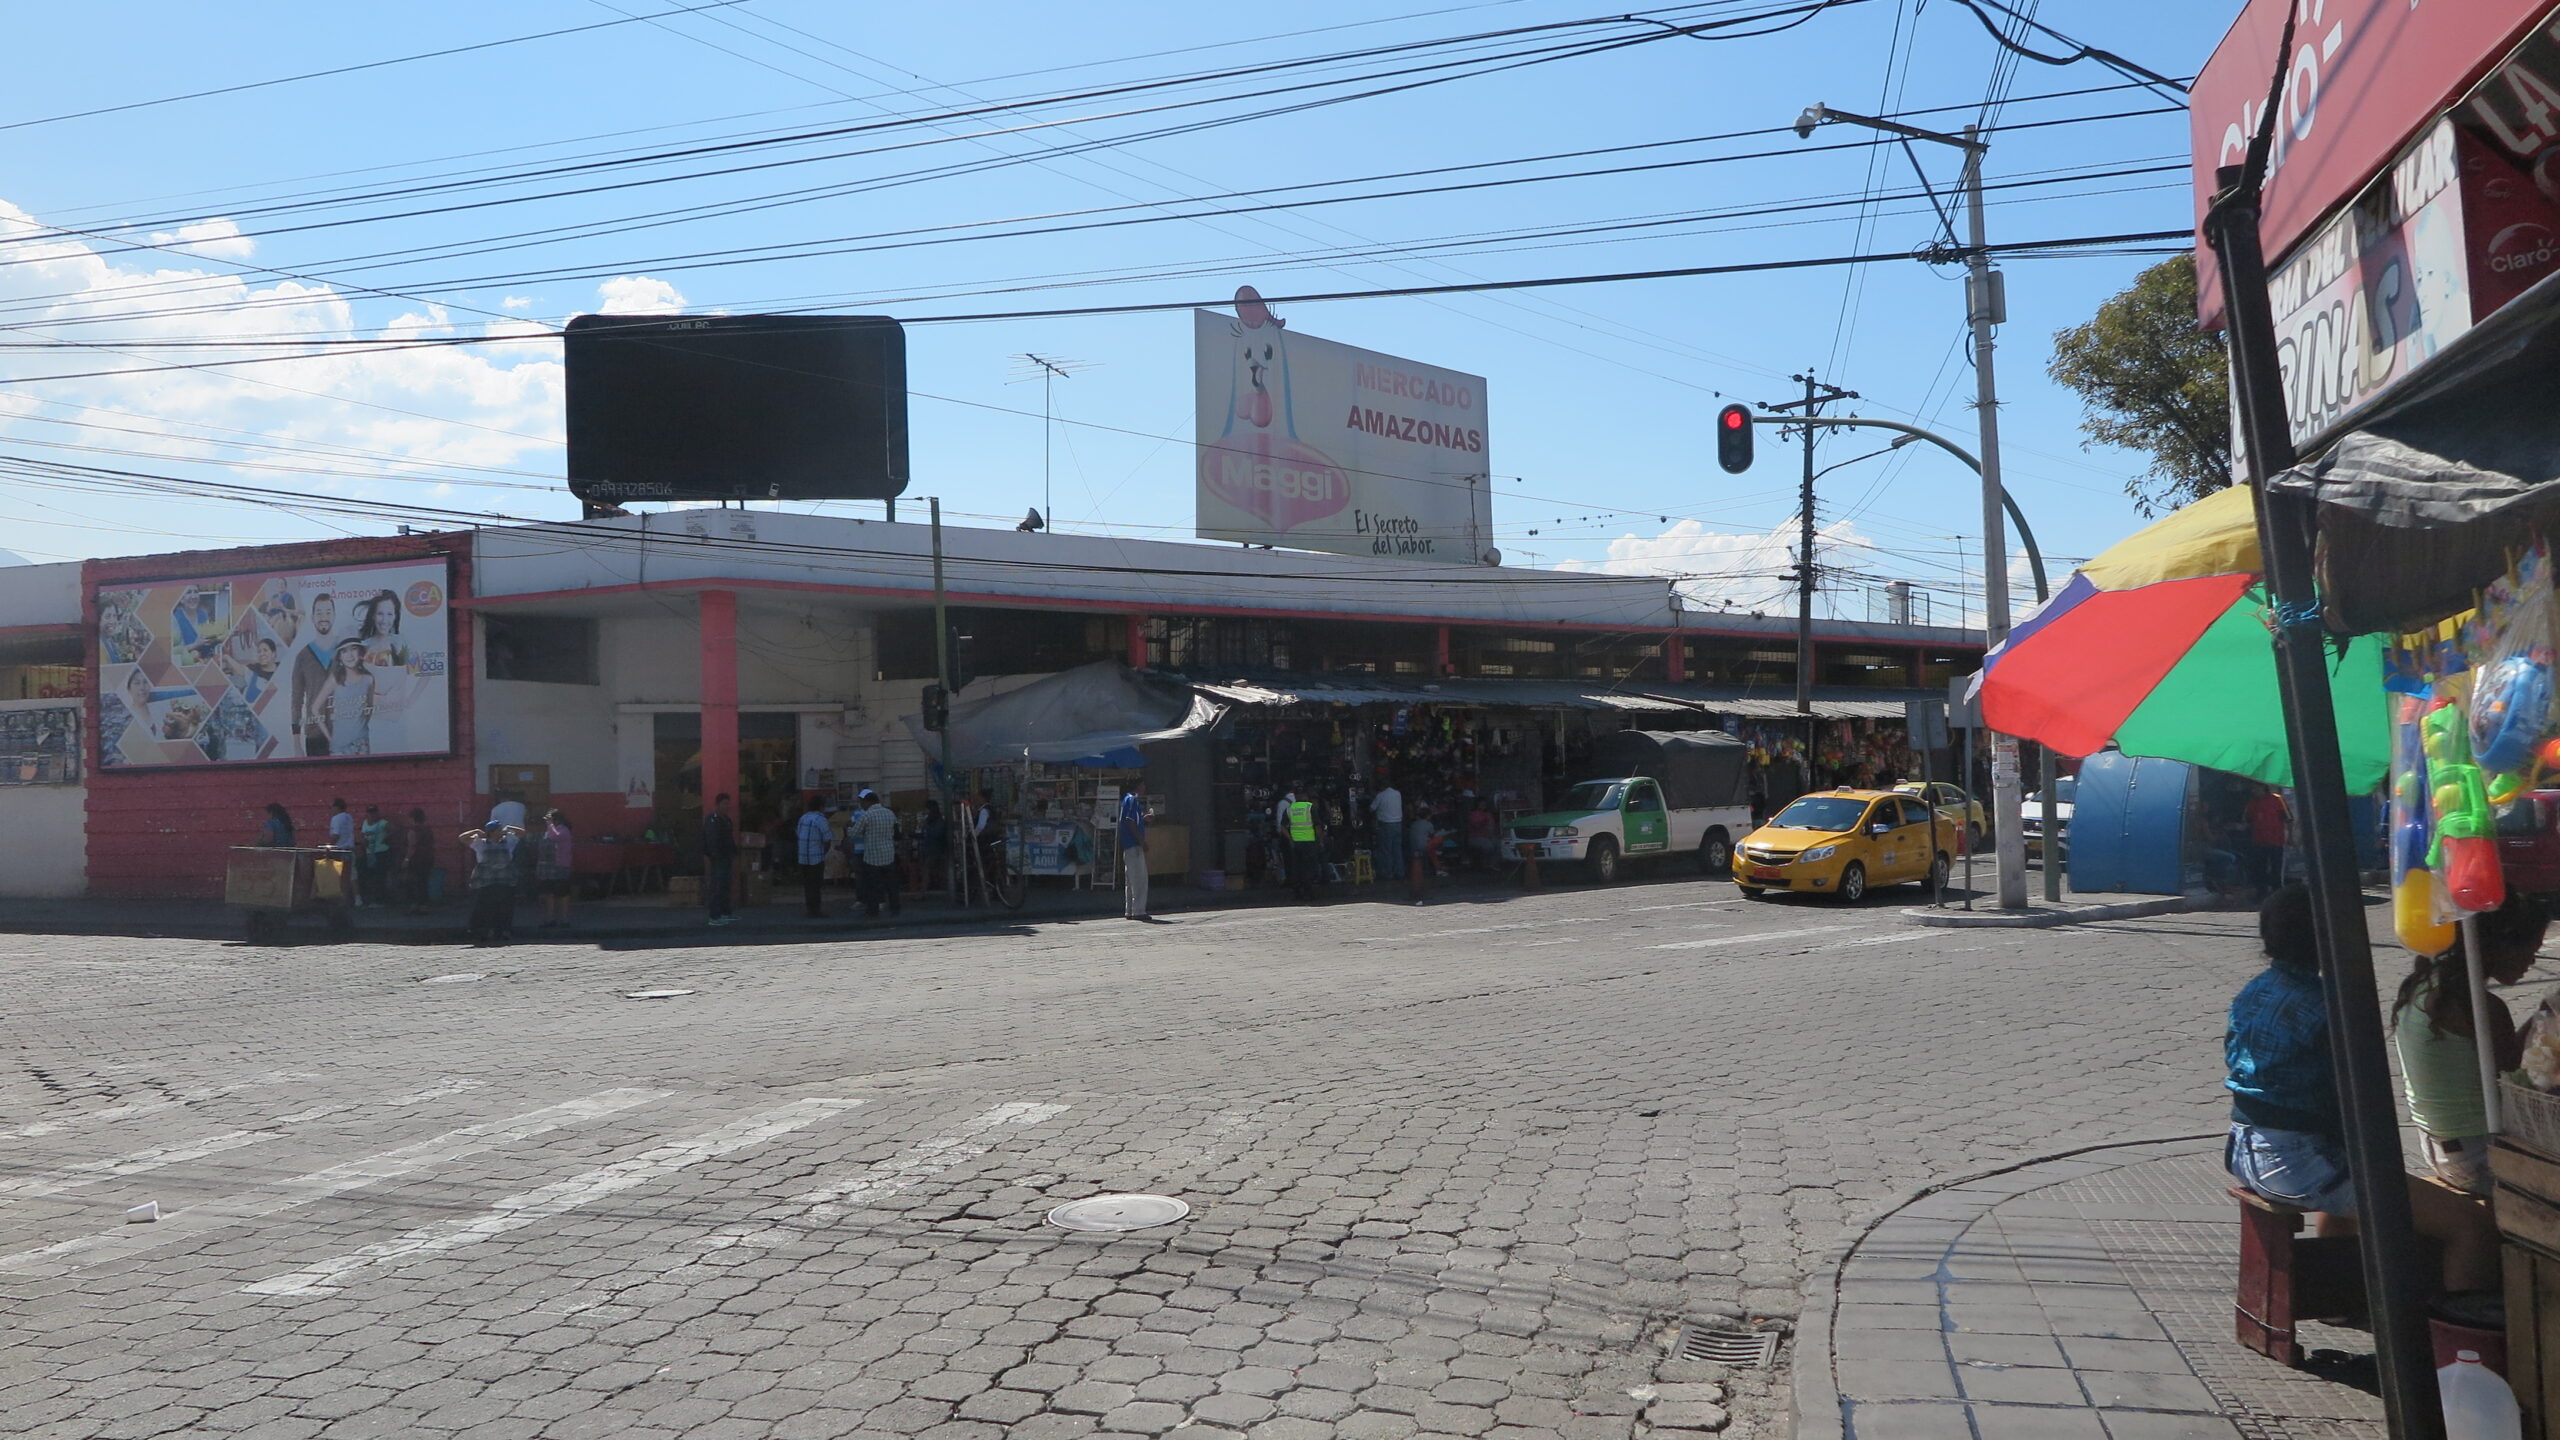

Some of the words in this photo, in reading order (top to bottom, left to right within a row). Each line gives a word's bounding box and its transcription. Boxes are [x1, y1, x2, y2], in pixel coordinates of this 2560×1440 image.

[2306, 223, 2345, 299] DEL
[2491, 246, 2550, 273] Claro
[1355, 363, 1473, 410] MERCADO
[1346, 405, 1482, 453] AMAZONAS
[1222, 455, 1333, 500] Maggi
[1354, 509, 1369, 534] El
[1373, 514, 1418, 534] Secreto
[1372, 534, 1393, 555] del
[1395, 535, 1435, 556] Sabor.
[298, 577, 336, 590] Mercado
